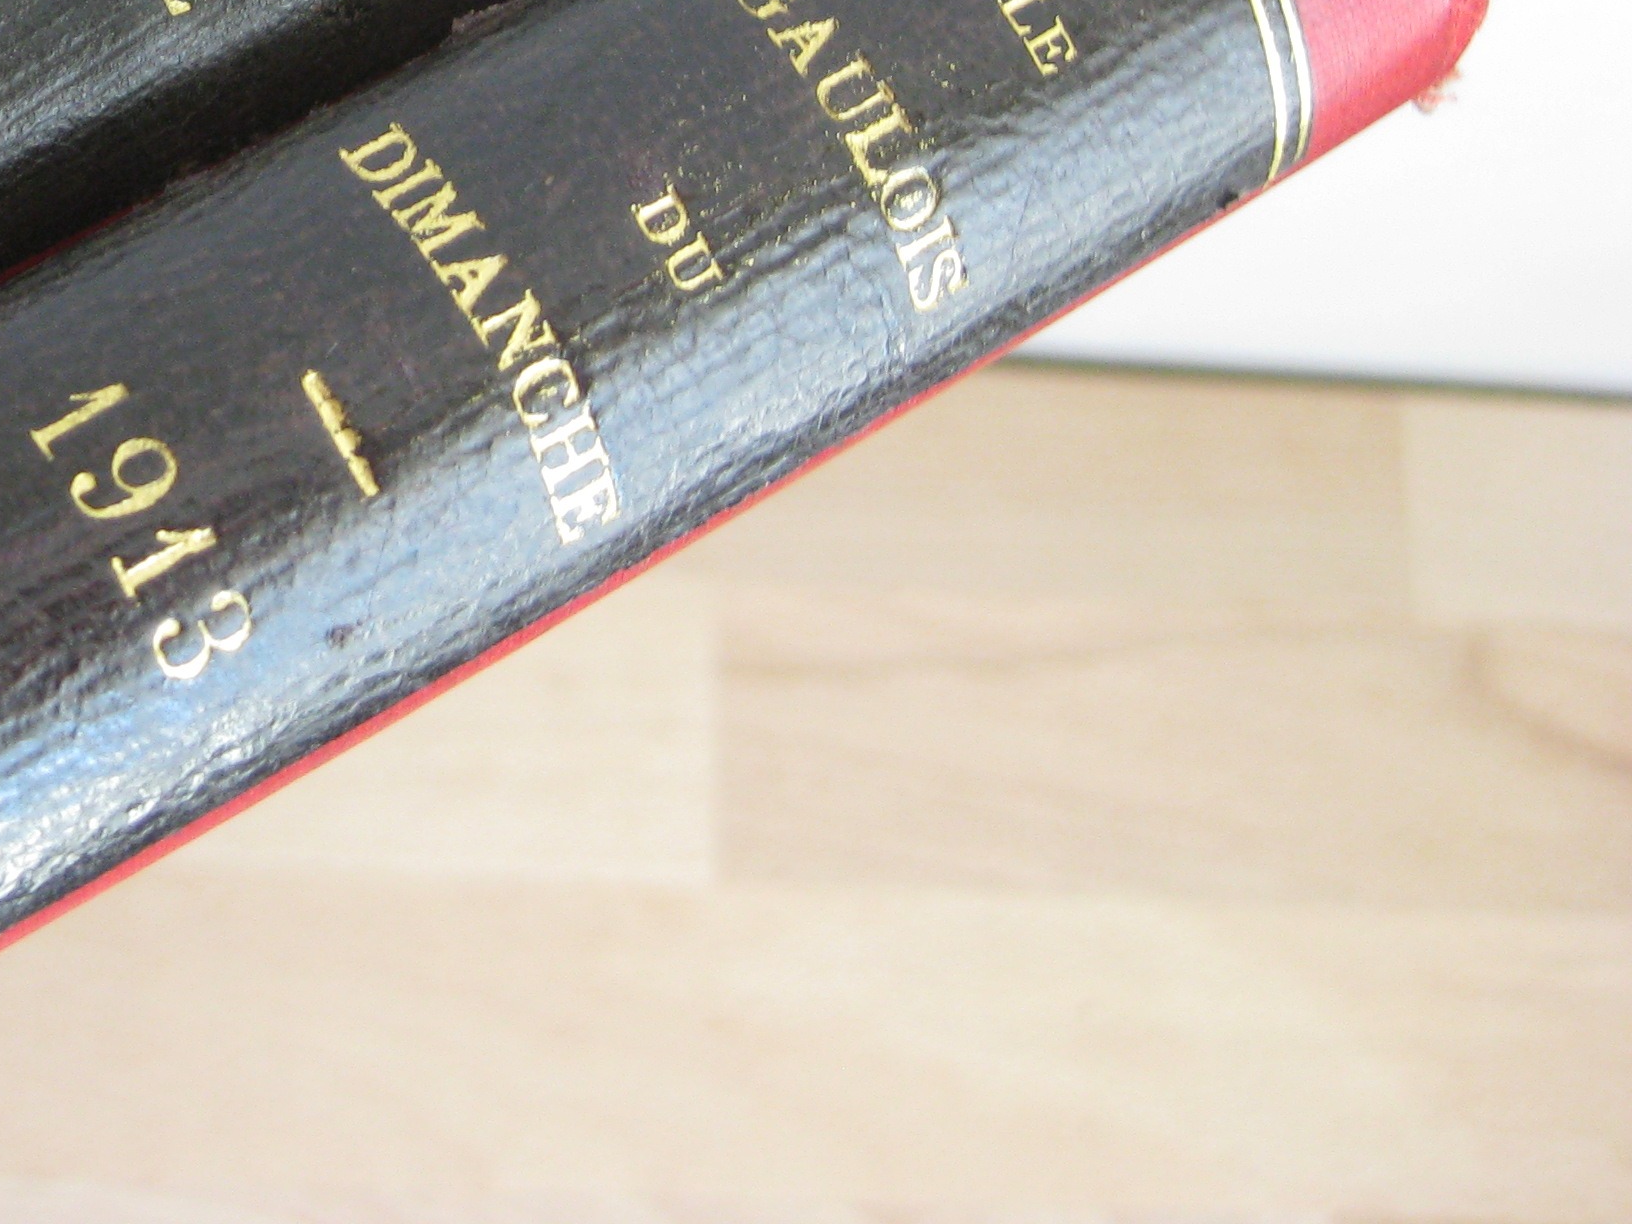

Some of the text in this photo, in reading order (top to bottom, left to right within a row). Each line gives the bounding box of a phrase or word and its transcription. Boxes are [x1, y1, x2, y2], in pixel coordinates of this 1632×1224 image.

[337, 122, 621, 546] DIMANCHE
[630, 183, 726, 293] DU
[29, 381, 254, 681] 1913
